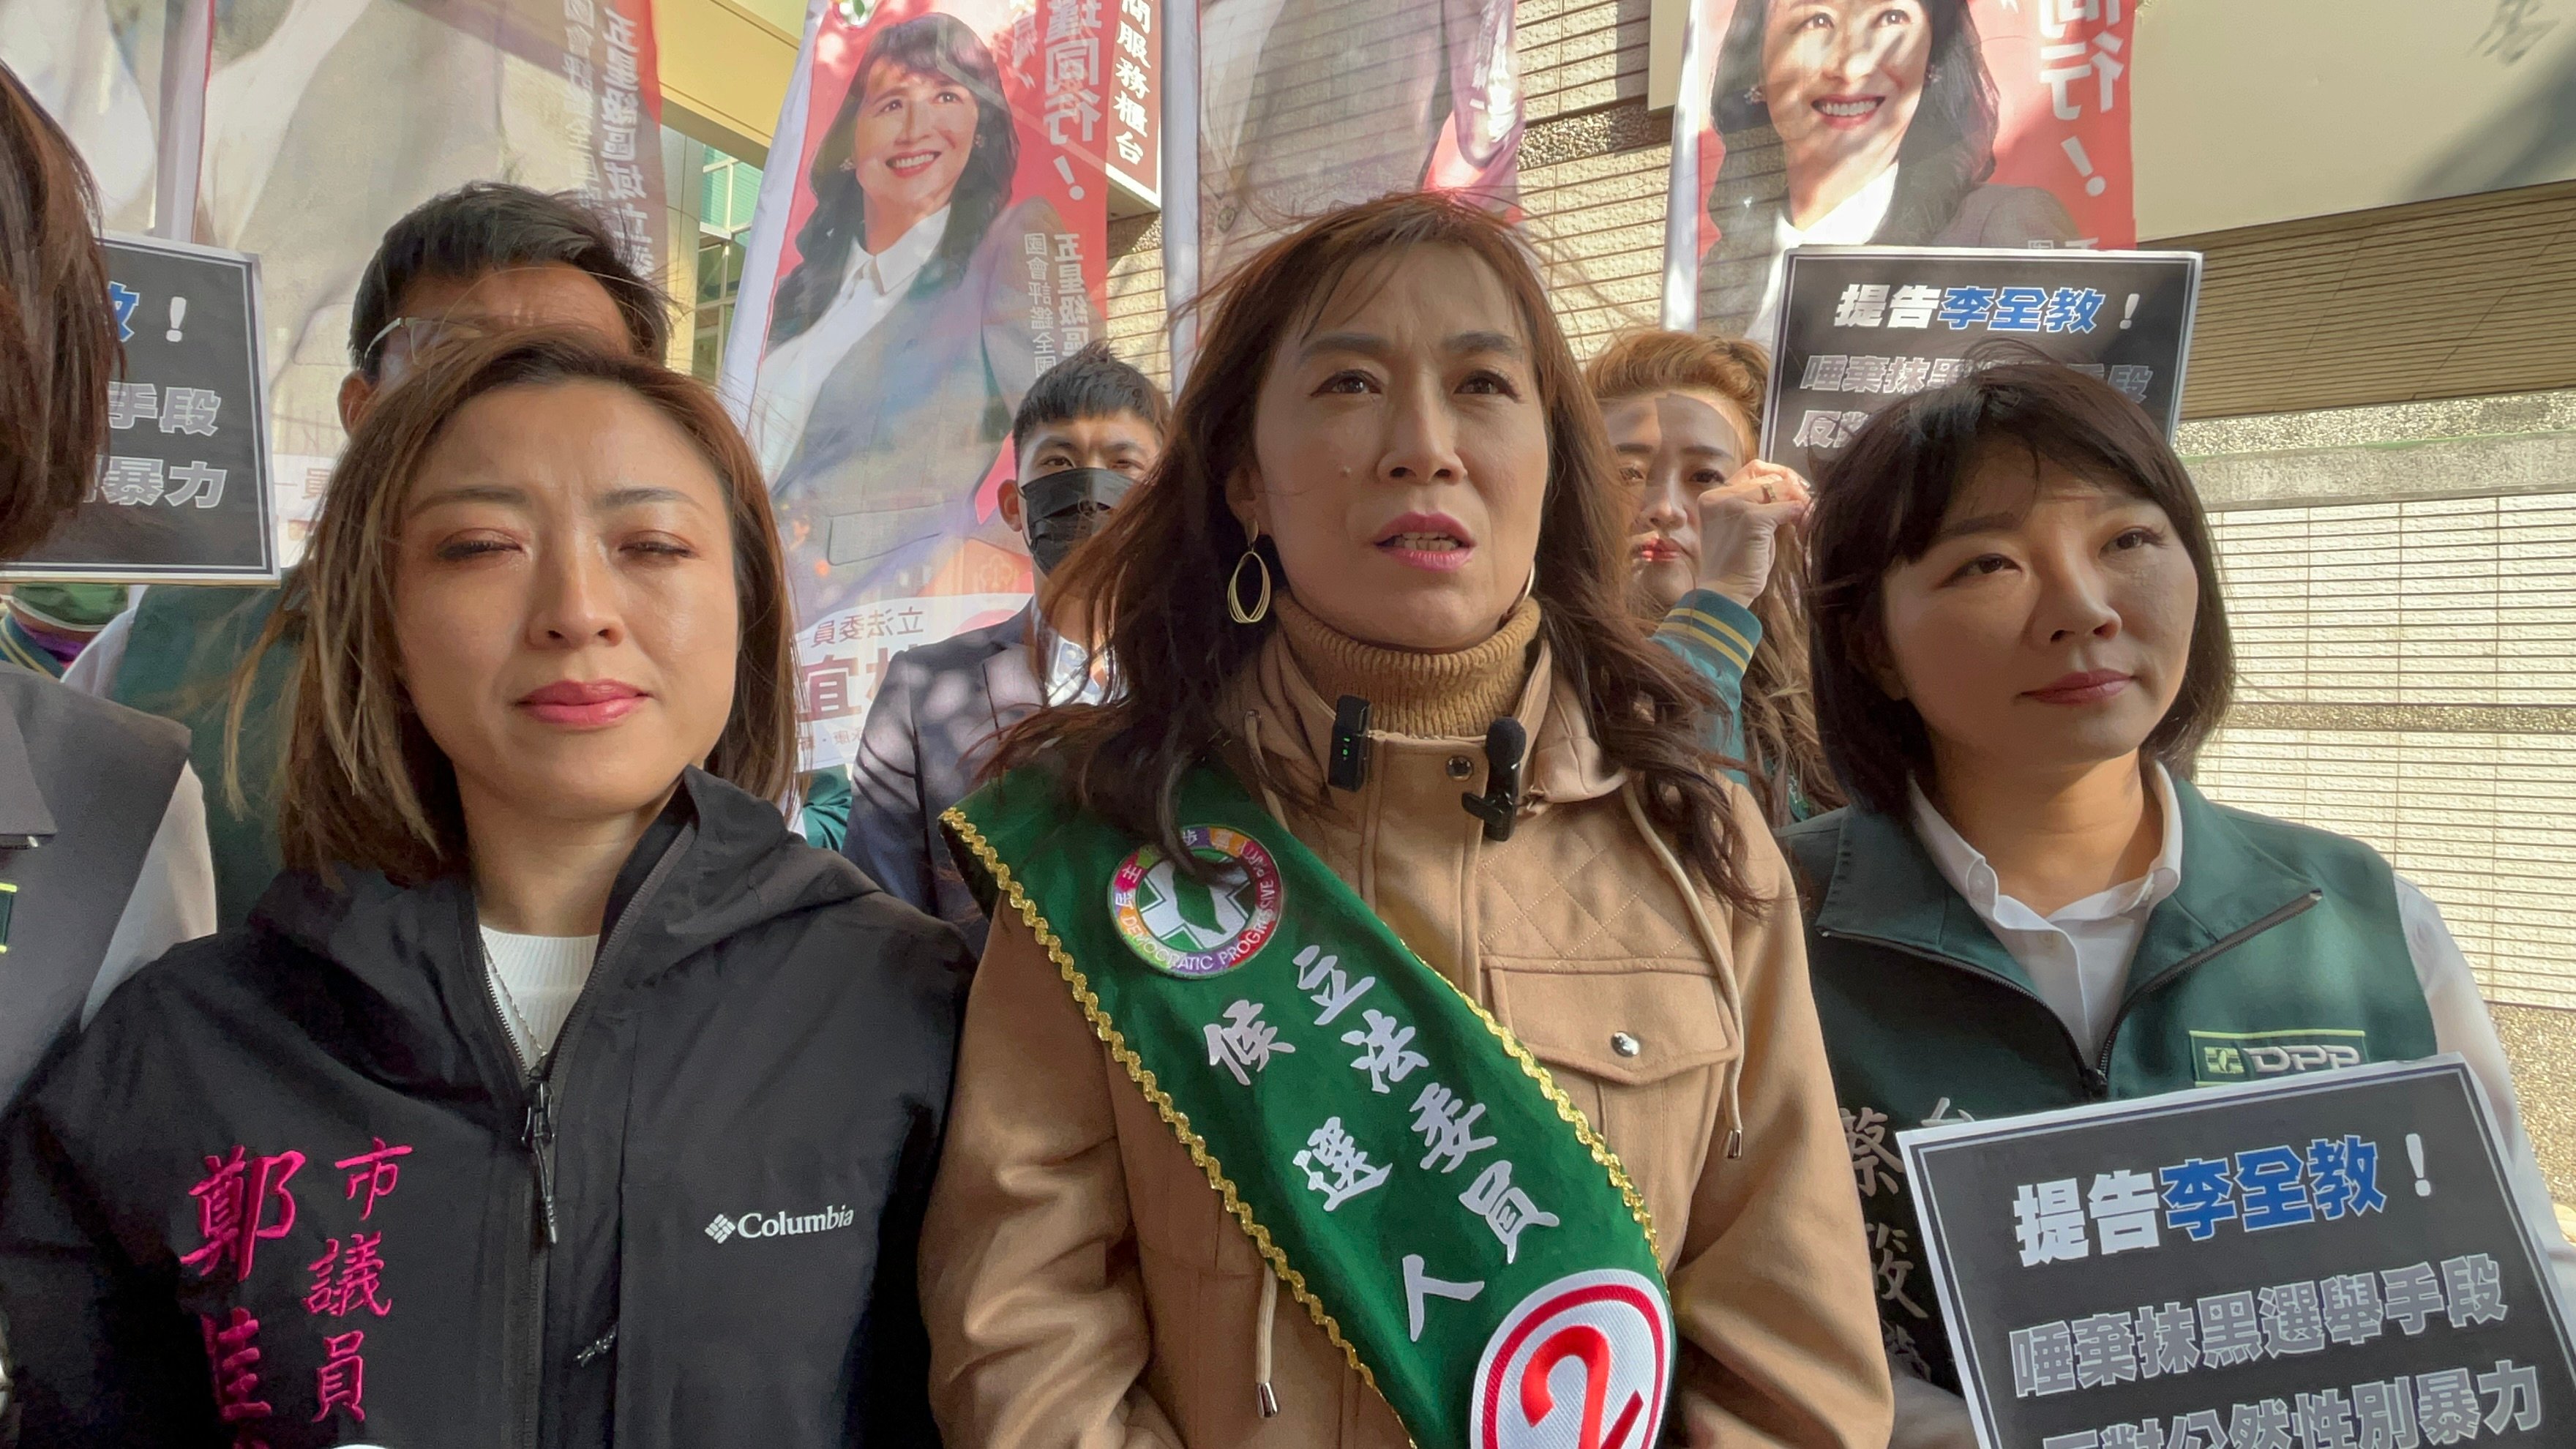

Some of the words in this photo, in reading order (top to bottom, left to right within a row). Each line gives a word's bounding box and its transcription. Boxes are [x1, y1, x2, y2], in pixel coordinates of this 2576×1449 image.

[83, 453, 228, 509] 暴力
[1121, 915, 1215, 971] DEMOCRATIC
[1218, 879, 1276, 966] PROGRESSIVE
[1292, 945, 1560, 1265] 立法委員
[2242, 1044, 2361, 1073] DPP
[737, 1205, 854, 1238] Columbia
[1205, 998, 1485, 1342] 候選人
[2012, 1133, 2433, 1267] 提告李全教！
[179, 1144, 307, 1449] 鄭佳
[301, 1137, 413, 1423] 市議員
[2008, 1253, 2508, 1398] 唾棄抹黑選舉手段
[1520, 1325, 1644, 1449] 2
